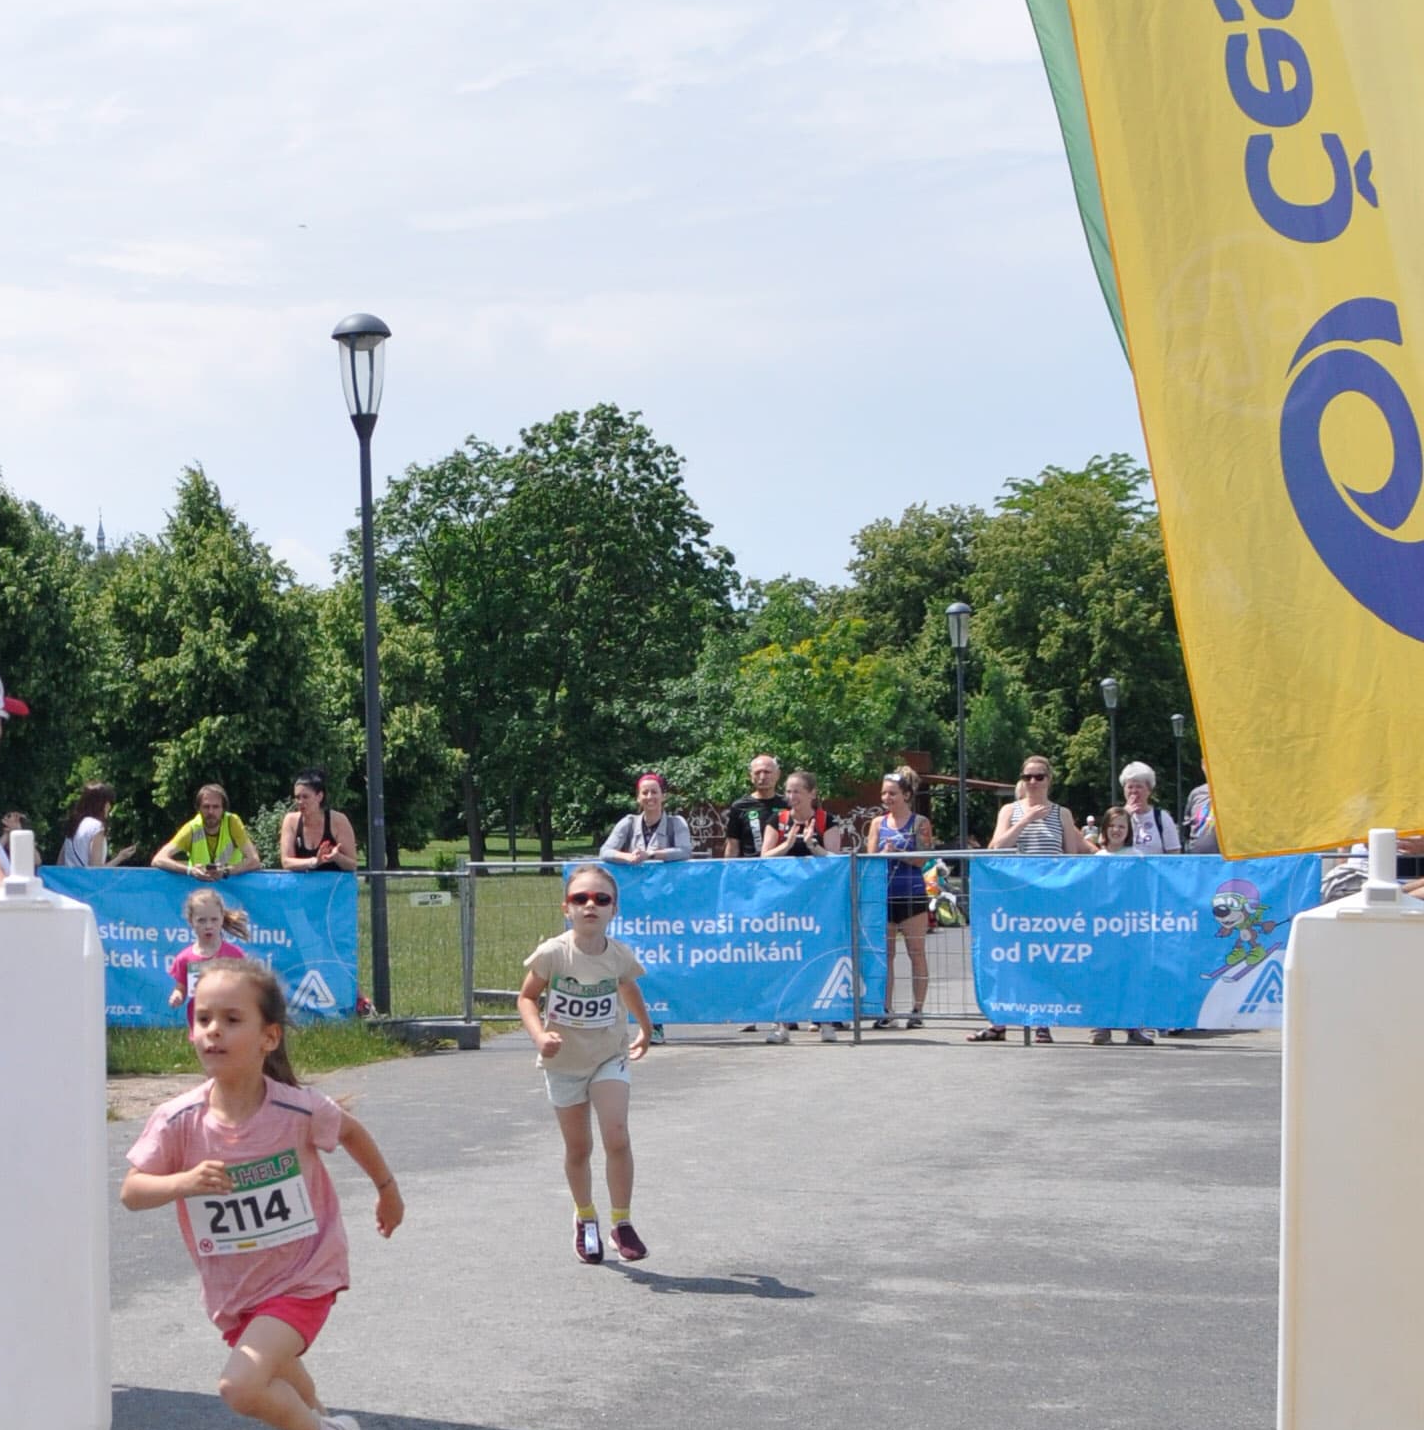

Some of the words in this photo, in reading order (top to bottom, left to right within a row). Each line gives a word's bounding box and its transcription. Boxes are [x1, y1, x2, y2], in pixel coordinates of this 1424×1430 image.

[98, 920, 159, 941] stíme
[606, 914, 685, 939] jistíme
[691, 911, 733, 935] vaši
[740, 910, 821, 935] rodinu,
[991, 907, 1085, 932] Úrazové
[1093, 910, 1199, 937] pojištění
[635, 943, 671, 964] tek
[678, 943, 684, 964] i
[690, 939, 803, 968] podnikání
[991, 943, 1021, 963] od
[1028, 943, 1093, 963] PVZP
[554, 994, 612, 1018] 2099
[989, 1001, 1083, 1015] www.pvzp.cz
[239, 1154, 294, 1187] HELP
[203, 1188, 292, 1234] 2114
